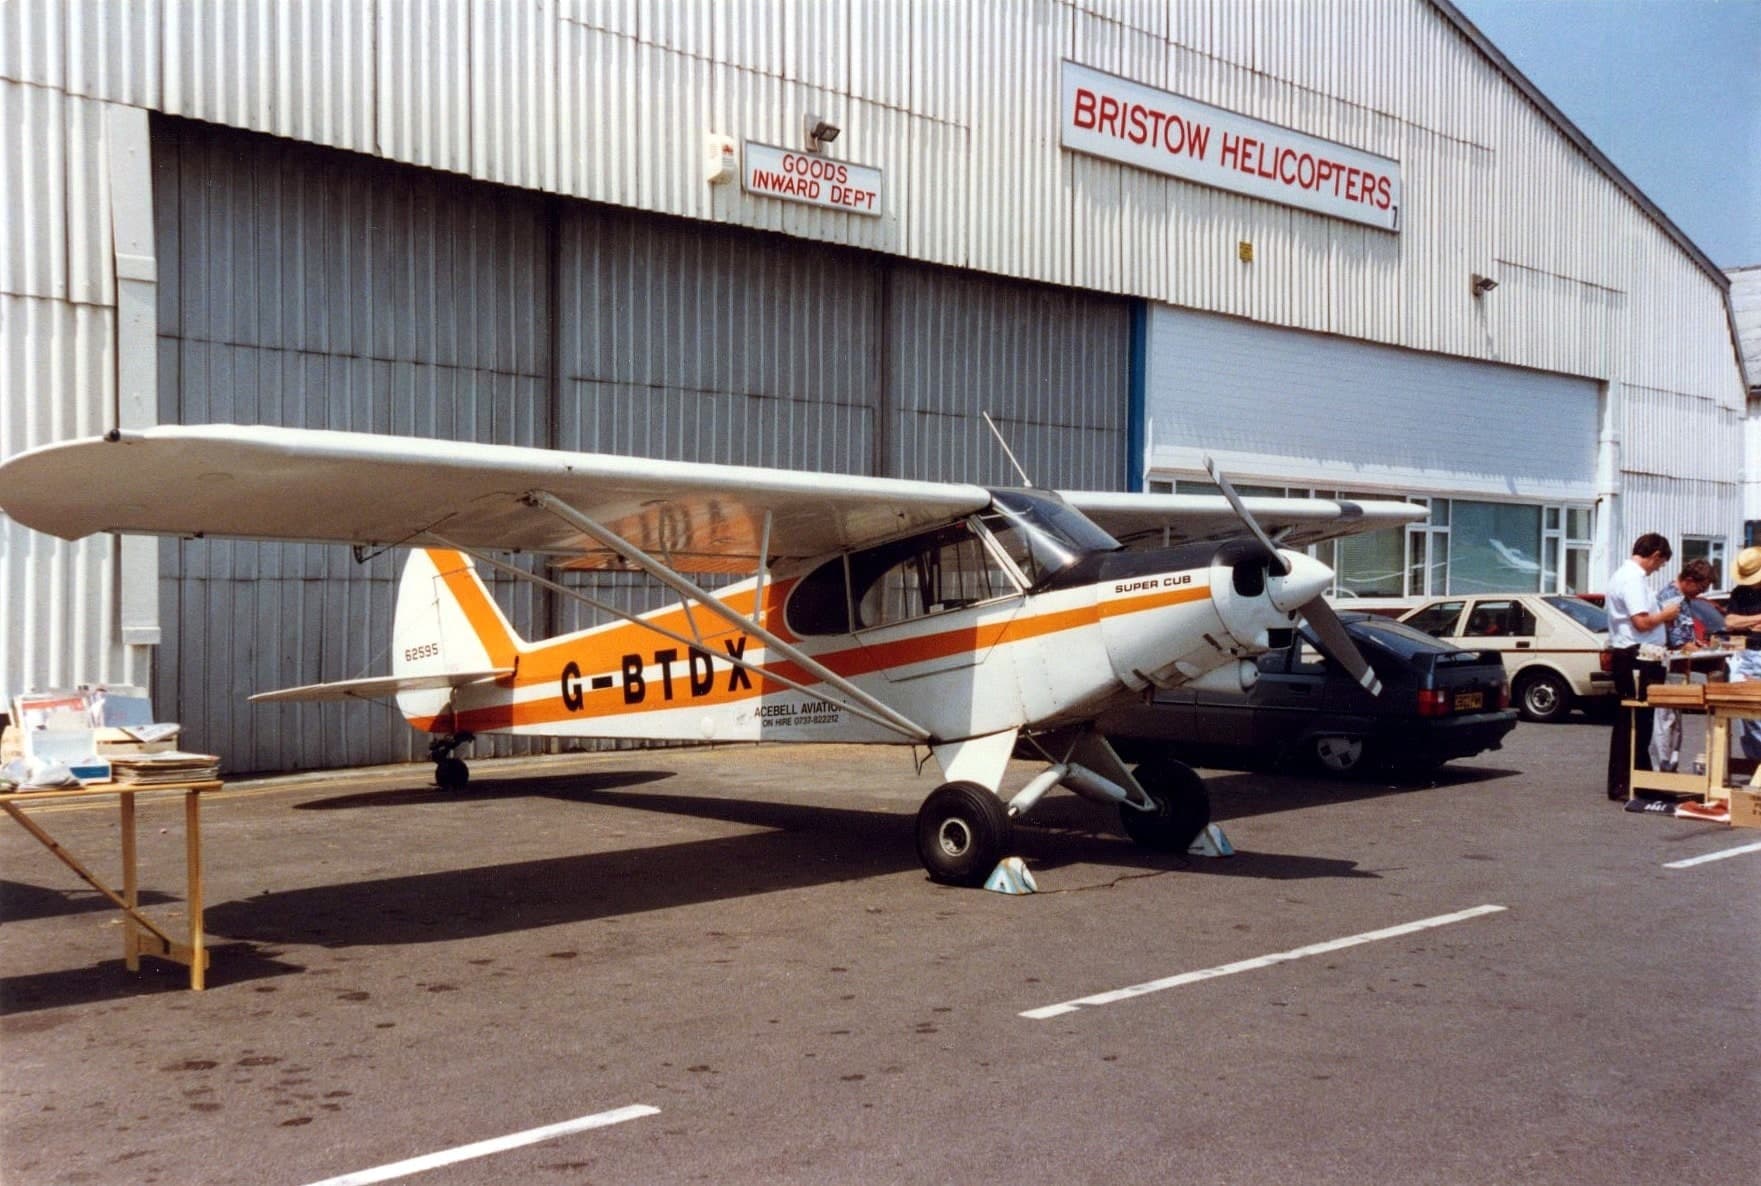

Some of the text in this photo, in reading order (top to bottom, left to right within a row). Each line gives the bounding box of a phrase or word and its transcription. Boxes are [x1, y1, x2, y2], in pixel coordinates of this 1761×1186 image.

[1073, 88, 1392, 210] BRISTOW HELICOPTERS
[783, 154, 848, 184] GOODS
[752, 169, 876, 210] INWARD DEPT
[1115, 575, 1191, 593] SUPER CUB
[405, 643, 439, 662] 62595
[561, 636, 752, 712] G-BTDX
[754, 703, 798, 717] ACEBELL
[762, 718, 774, 727] ON
[776, 717, 792, 727] HIRE
